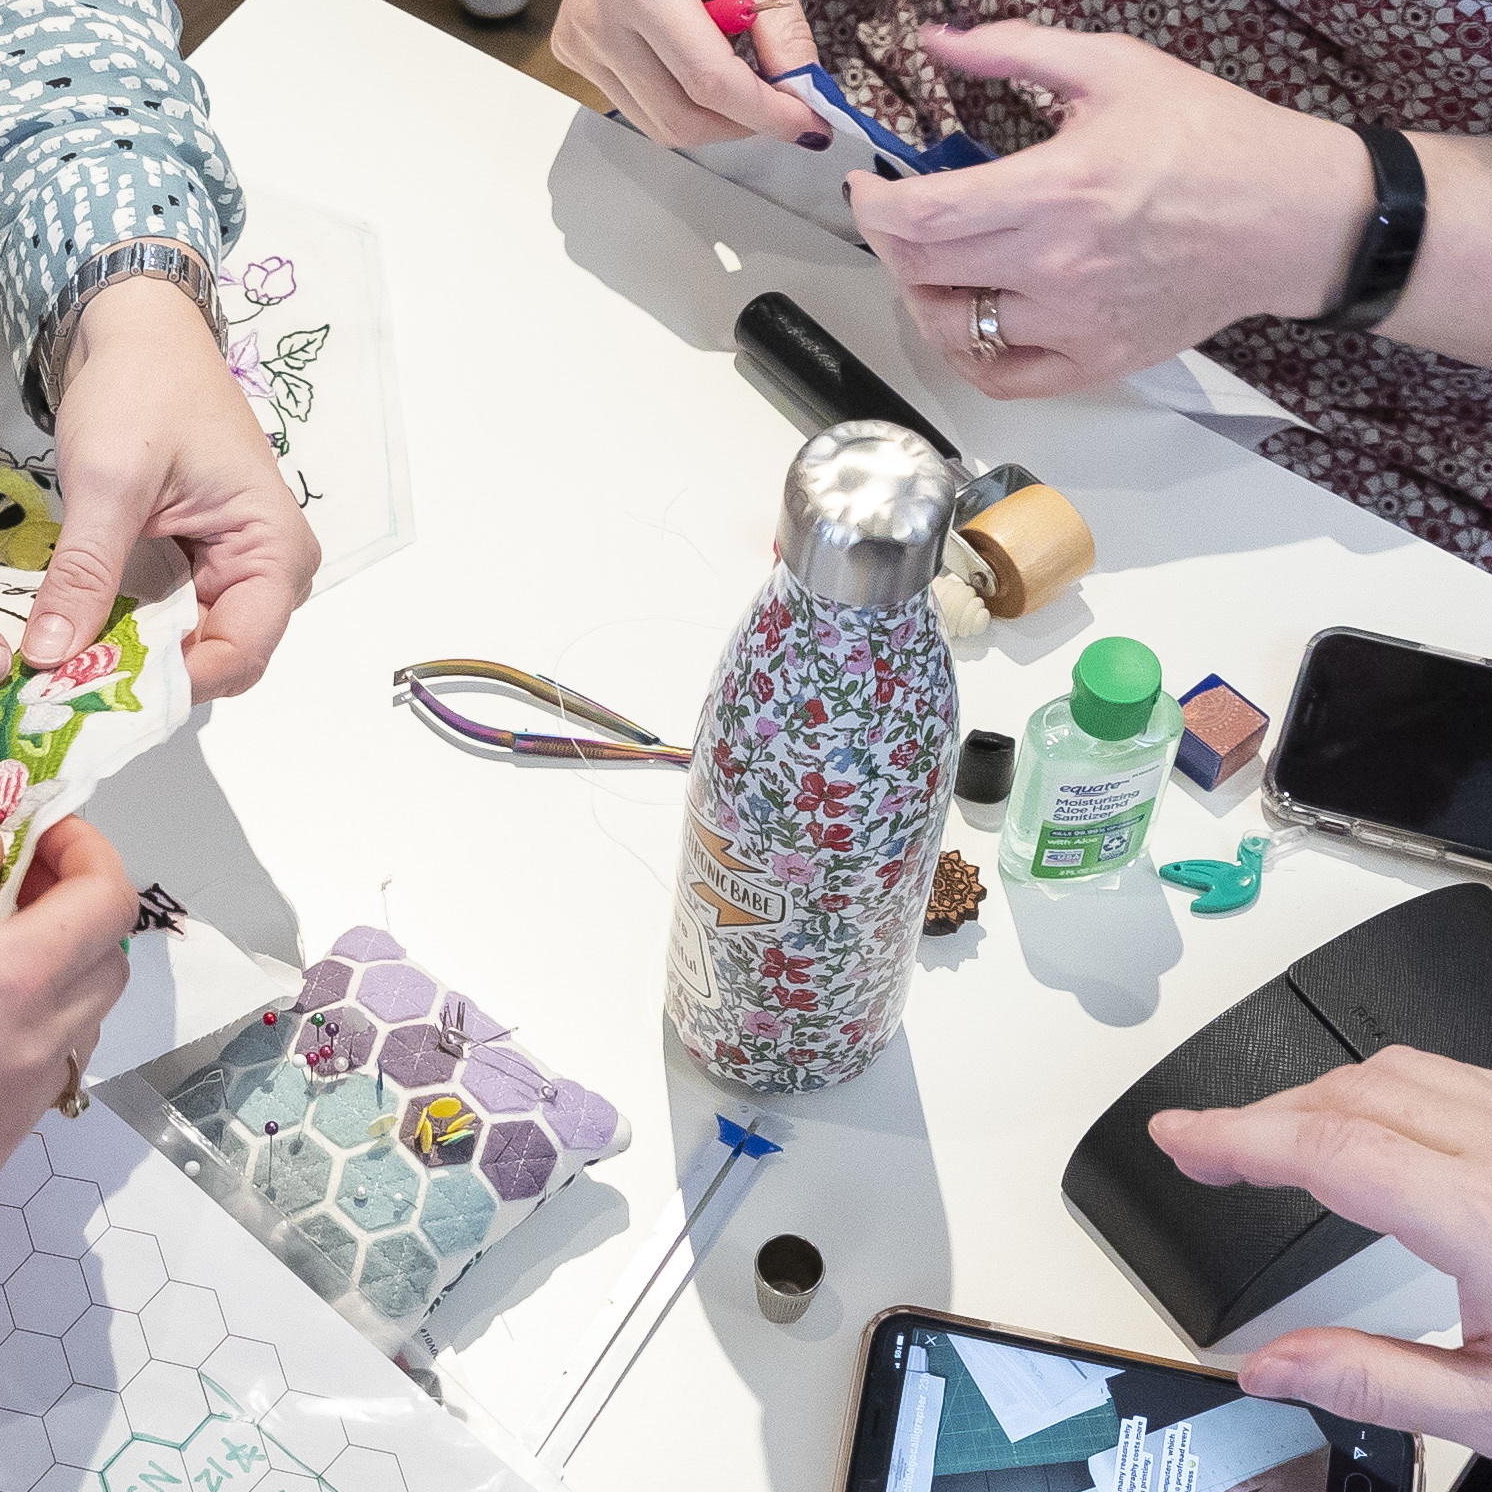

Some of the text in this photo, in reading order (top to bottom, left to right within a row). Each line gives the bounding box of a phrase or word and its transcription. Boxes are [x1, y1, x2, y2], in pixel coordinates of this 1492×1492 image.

[1060, 780, 1122, 797] equate
[1055, 799, 1129, 814] Aloe Hand
[1056, 790, 1140, 806] Moisturizing
[1052, 810, 1114, 821] Sanitizer
[731, 877, 775, 916] BABE
[1124, 1424, 1133, 1439] why
[1168, 1433, 1176, 1456] which
[1120, 1441, 1129, 1471] reasons
[1175, 1448, 1185, 1486] proofread
[1180, 1427, 1190, 1448] every
[1117, 1473, 1127, 1492] many
